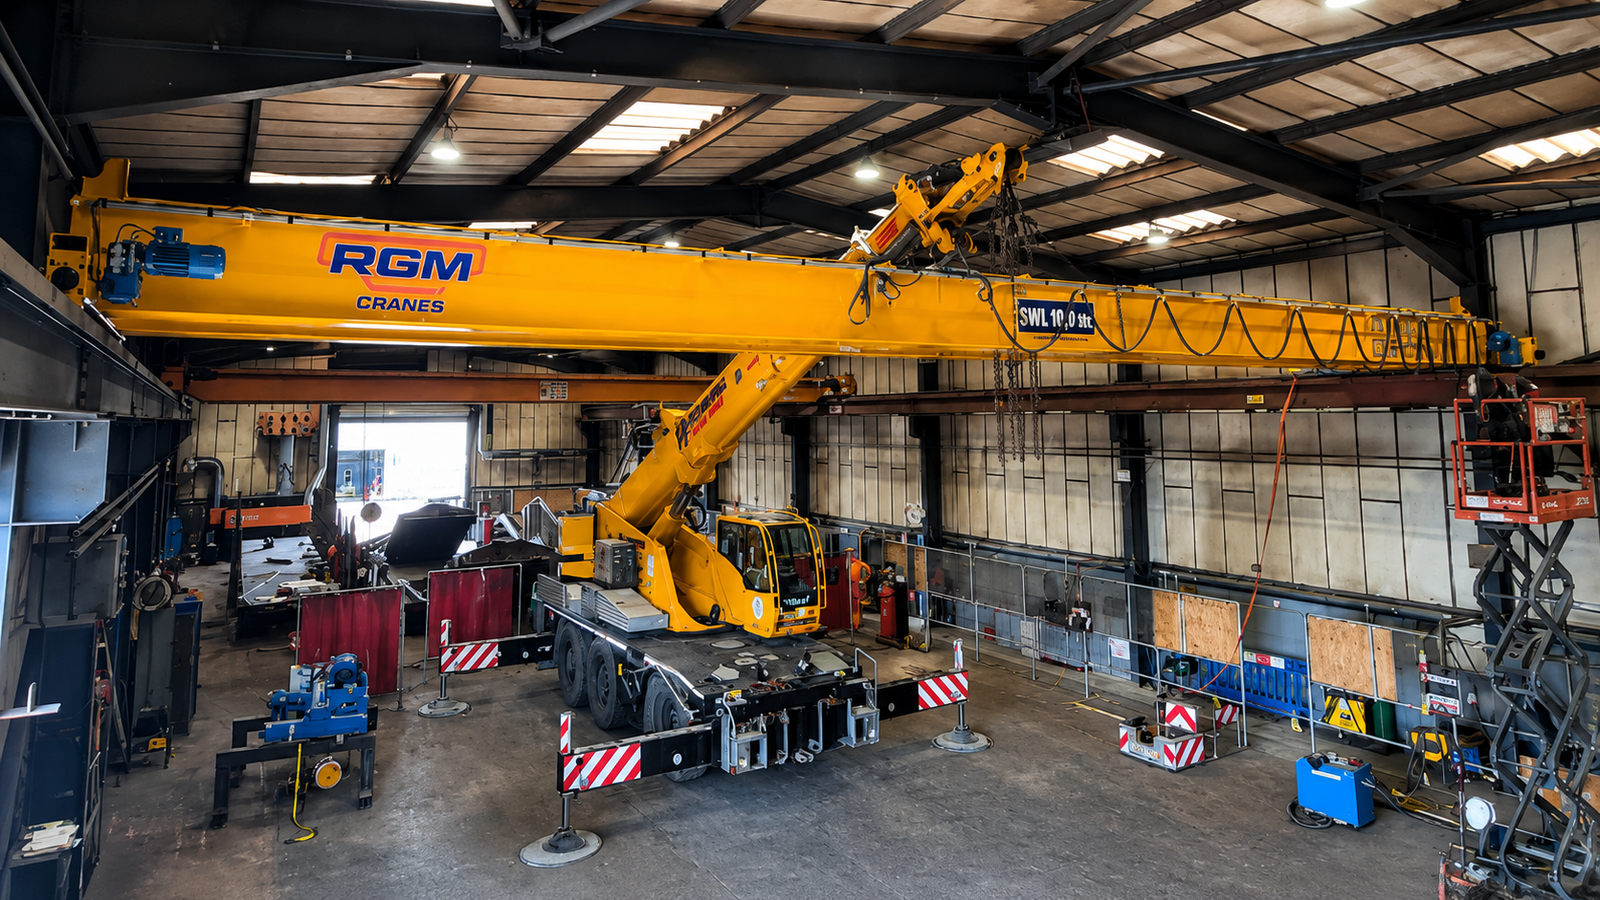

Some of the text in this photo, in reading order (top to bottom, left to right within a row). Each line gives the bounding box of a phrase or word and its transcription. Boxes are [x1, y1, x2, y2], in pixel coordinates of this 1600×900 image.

[329, 243, 474, 282] RGM
[356, 295, 446, 313] CRANES
[1019, 306, 1049, 327] SWL
